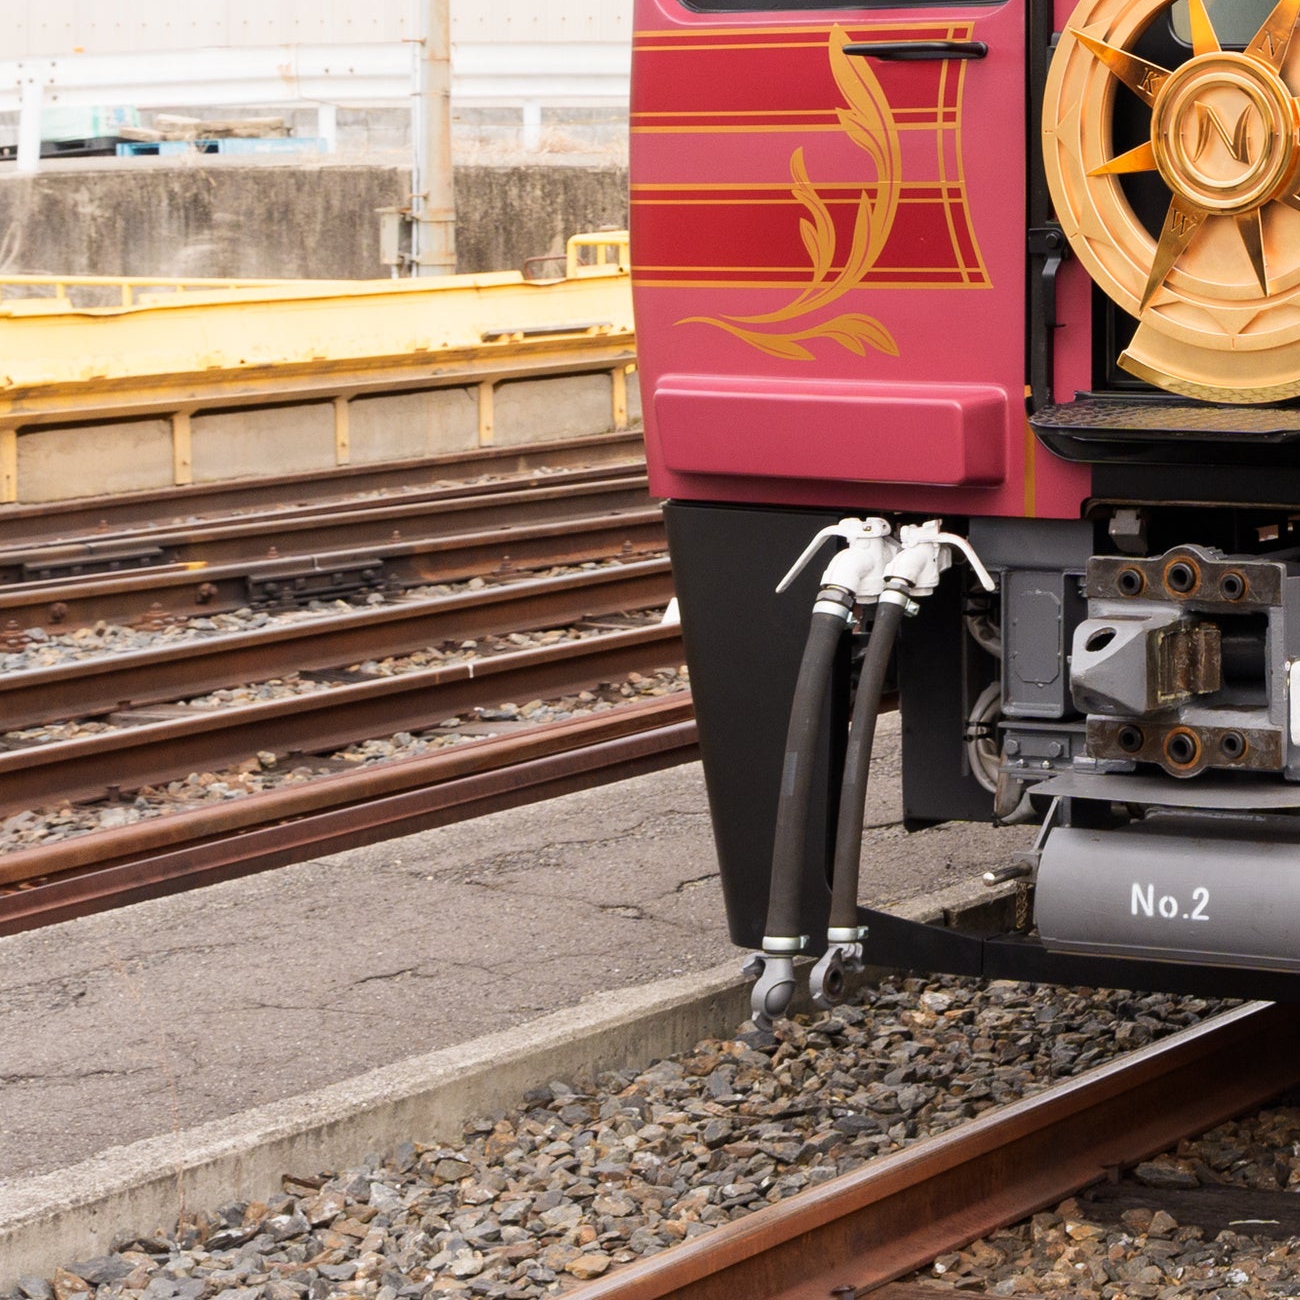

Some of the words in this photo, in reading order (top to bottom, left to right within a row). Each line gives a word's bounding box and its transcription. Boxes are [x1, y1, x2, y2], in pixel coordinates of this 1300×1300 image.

[1136, 67, 1163, 98] K
[1193, 100, 1252, 167] N
[1170, 208, 1199, 238] W
[1131, 882, 1209, 921] No.2
